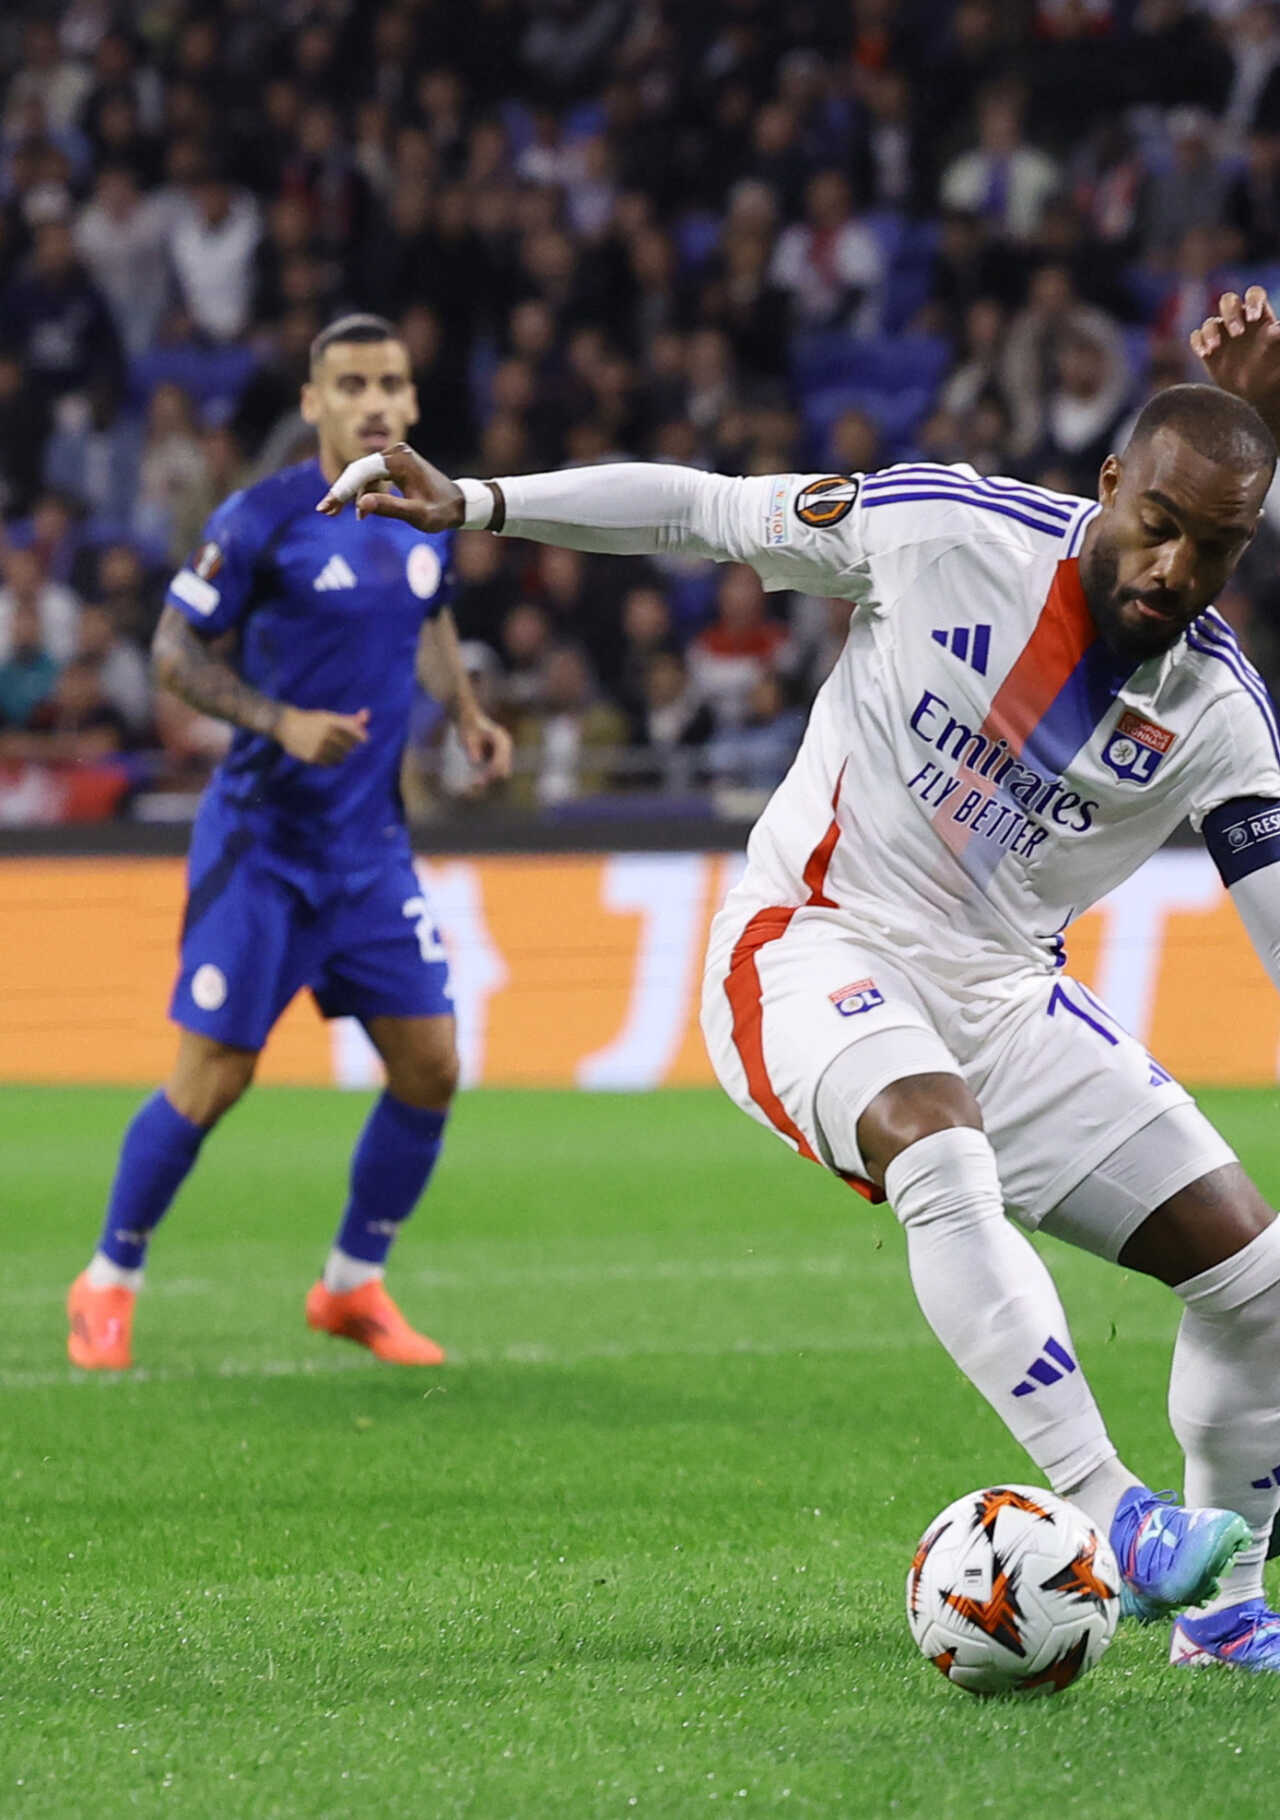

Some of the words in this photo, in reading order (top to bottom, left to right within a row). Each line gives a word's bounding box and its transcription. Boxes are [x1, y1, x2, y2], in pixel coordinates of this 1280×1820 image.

[909, 689, 1100, 832] Emirates
[1108, 738, 1151, 779] OL
[907, 761, 961, 808] FLY
[953, 789, 1049, 858] BETTER
